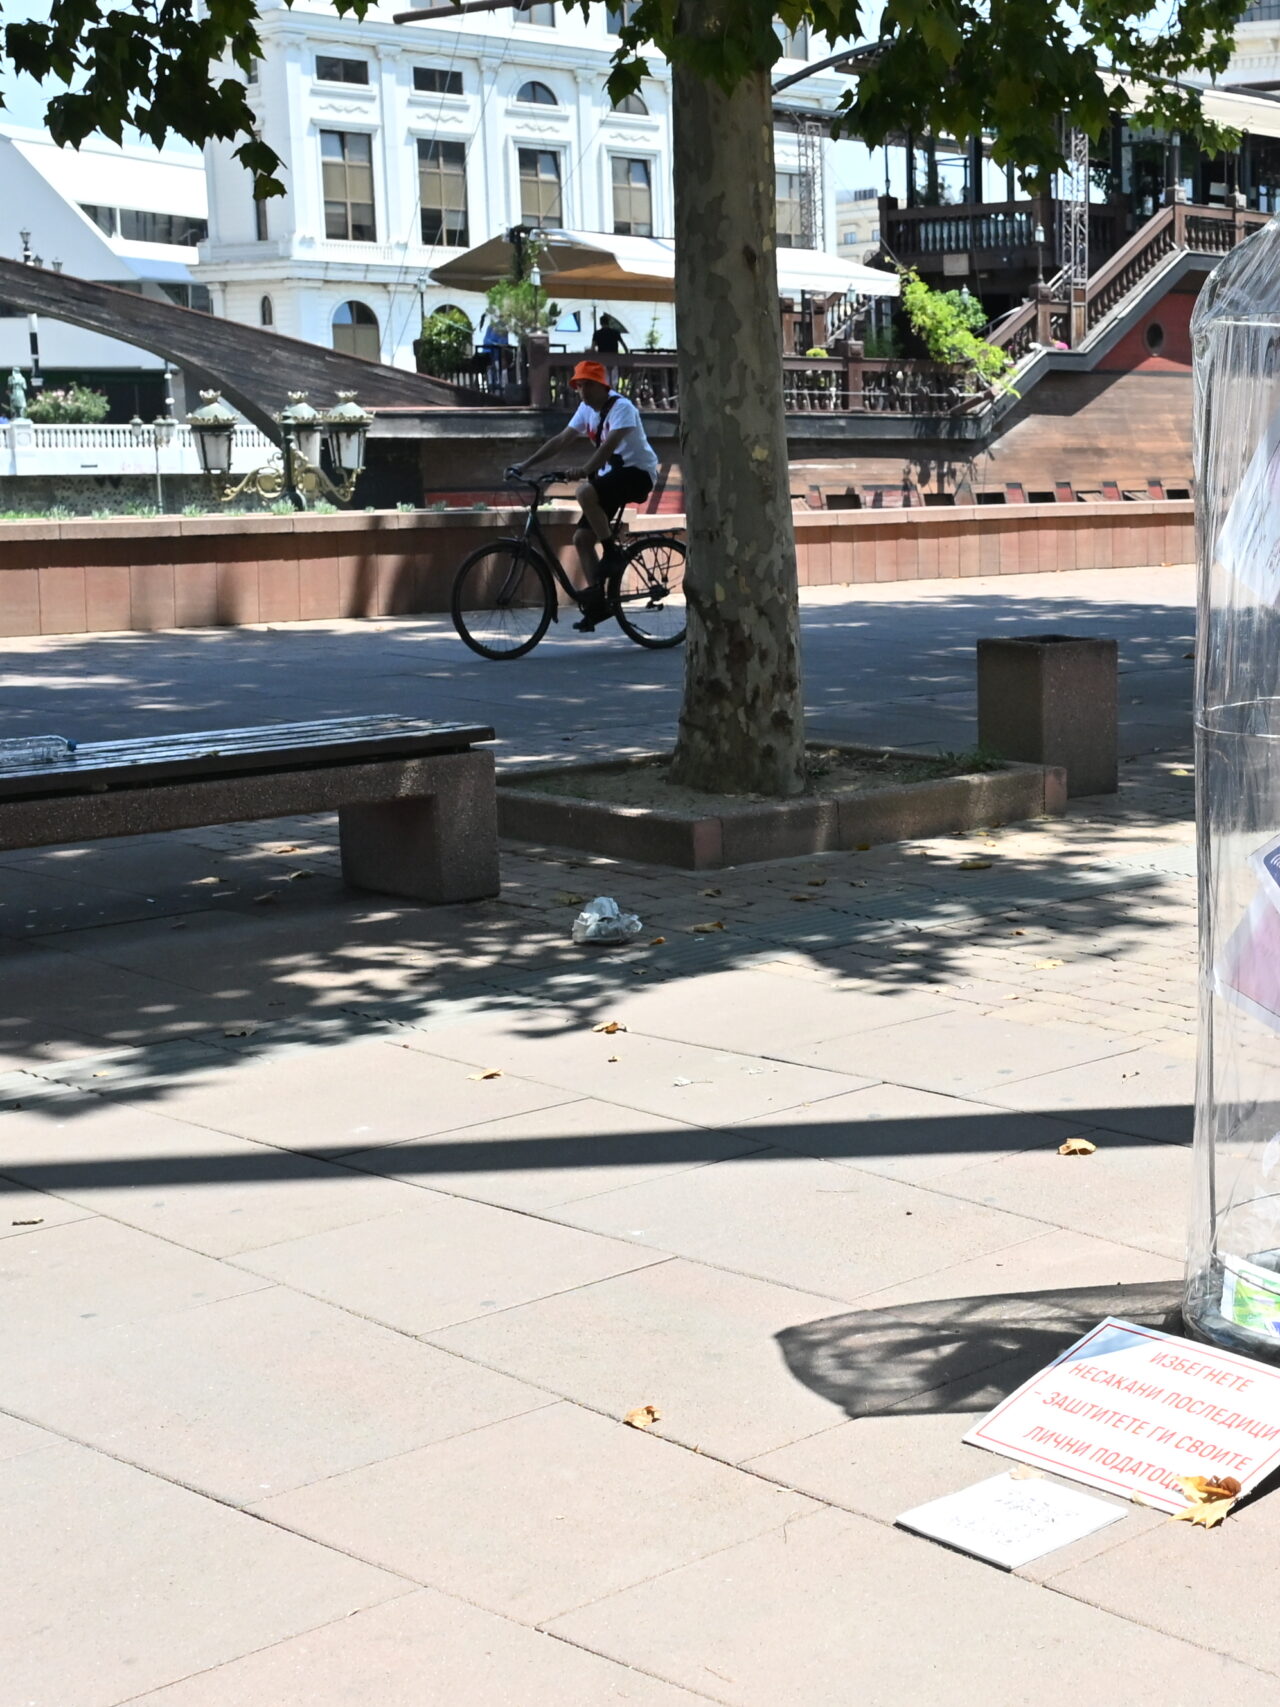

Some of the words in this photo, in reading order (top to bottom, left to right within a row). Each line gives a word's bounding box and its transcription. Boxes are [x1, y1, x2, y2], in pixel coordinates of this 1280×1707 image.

[1069, 1363, 1165, 1401] НЕСАКАНИ
[1149, 1351, 1255, 1393] ИЗБЕГНЕТЕ
[1022, 1425, 1093, 1457] ЛИЧНИ
[1043, 1391, 1150, 1435] ЗАШТИТЕТЕ
[1147, 1425, 1178, 1444] ГИ
[1174, 1435, 1253, 1471] СВОИТЕ
